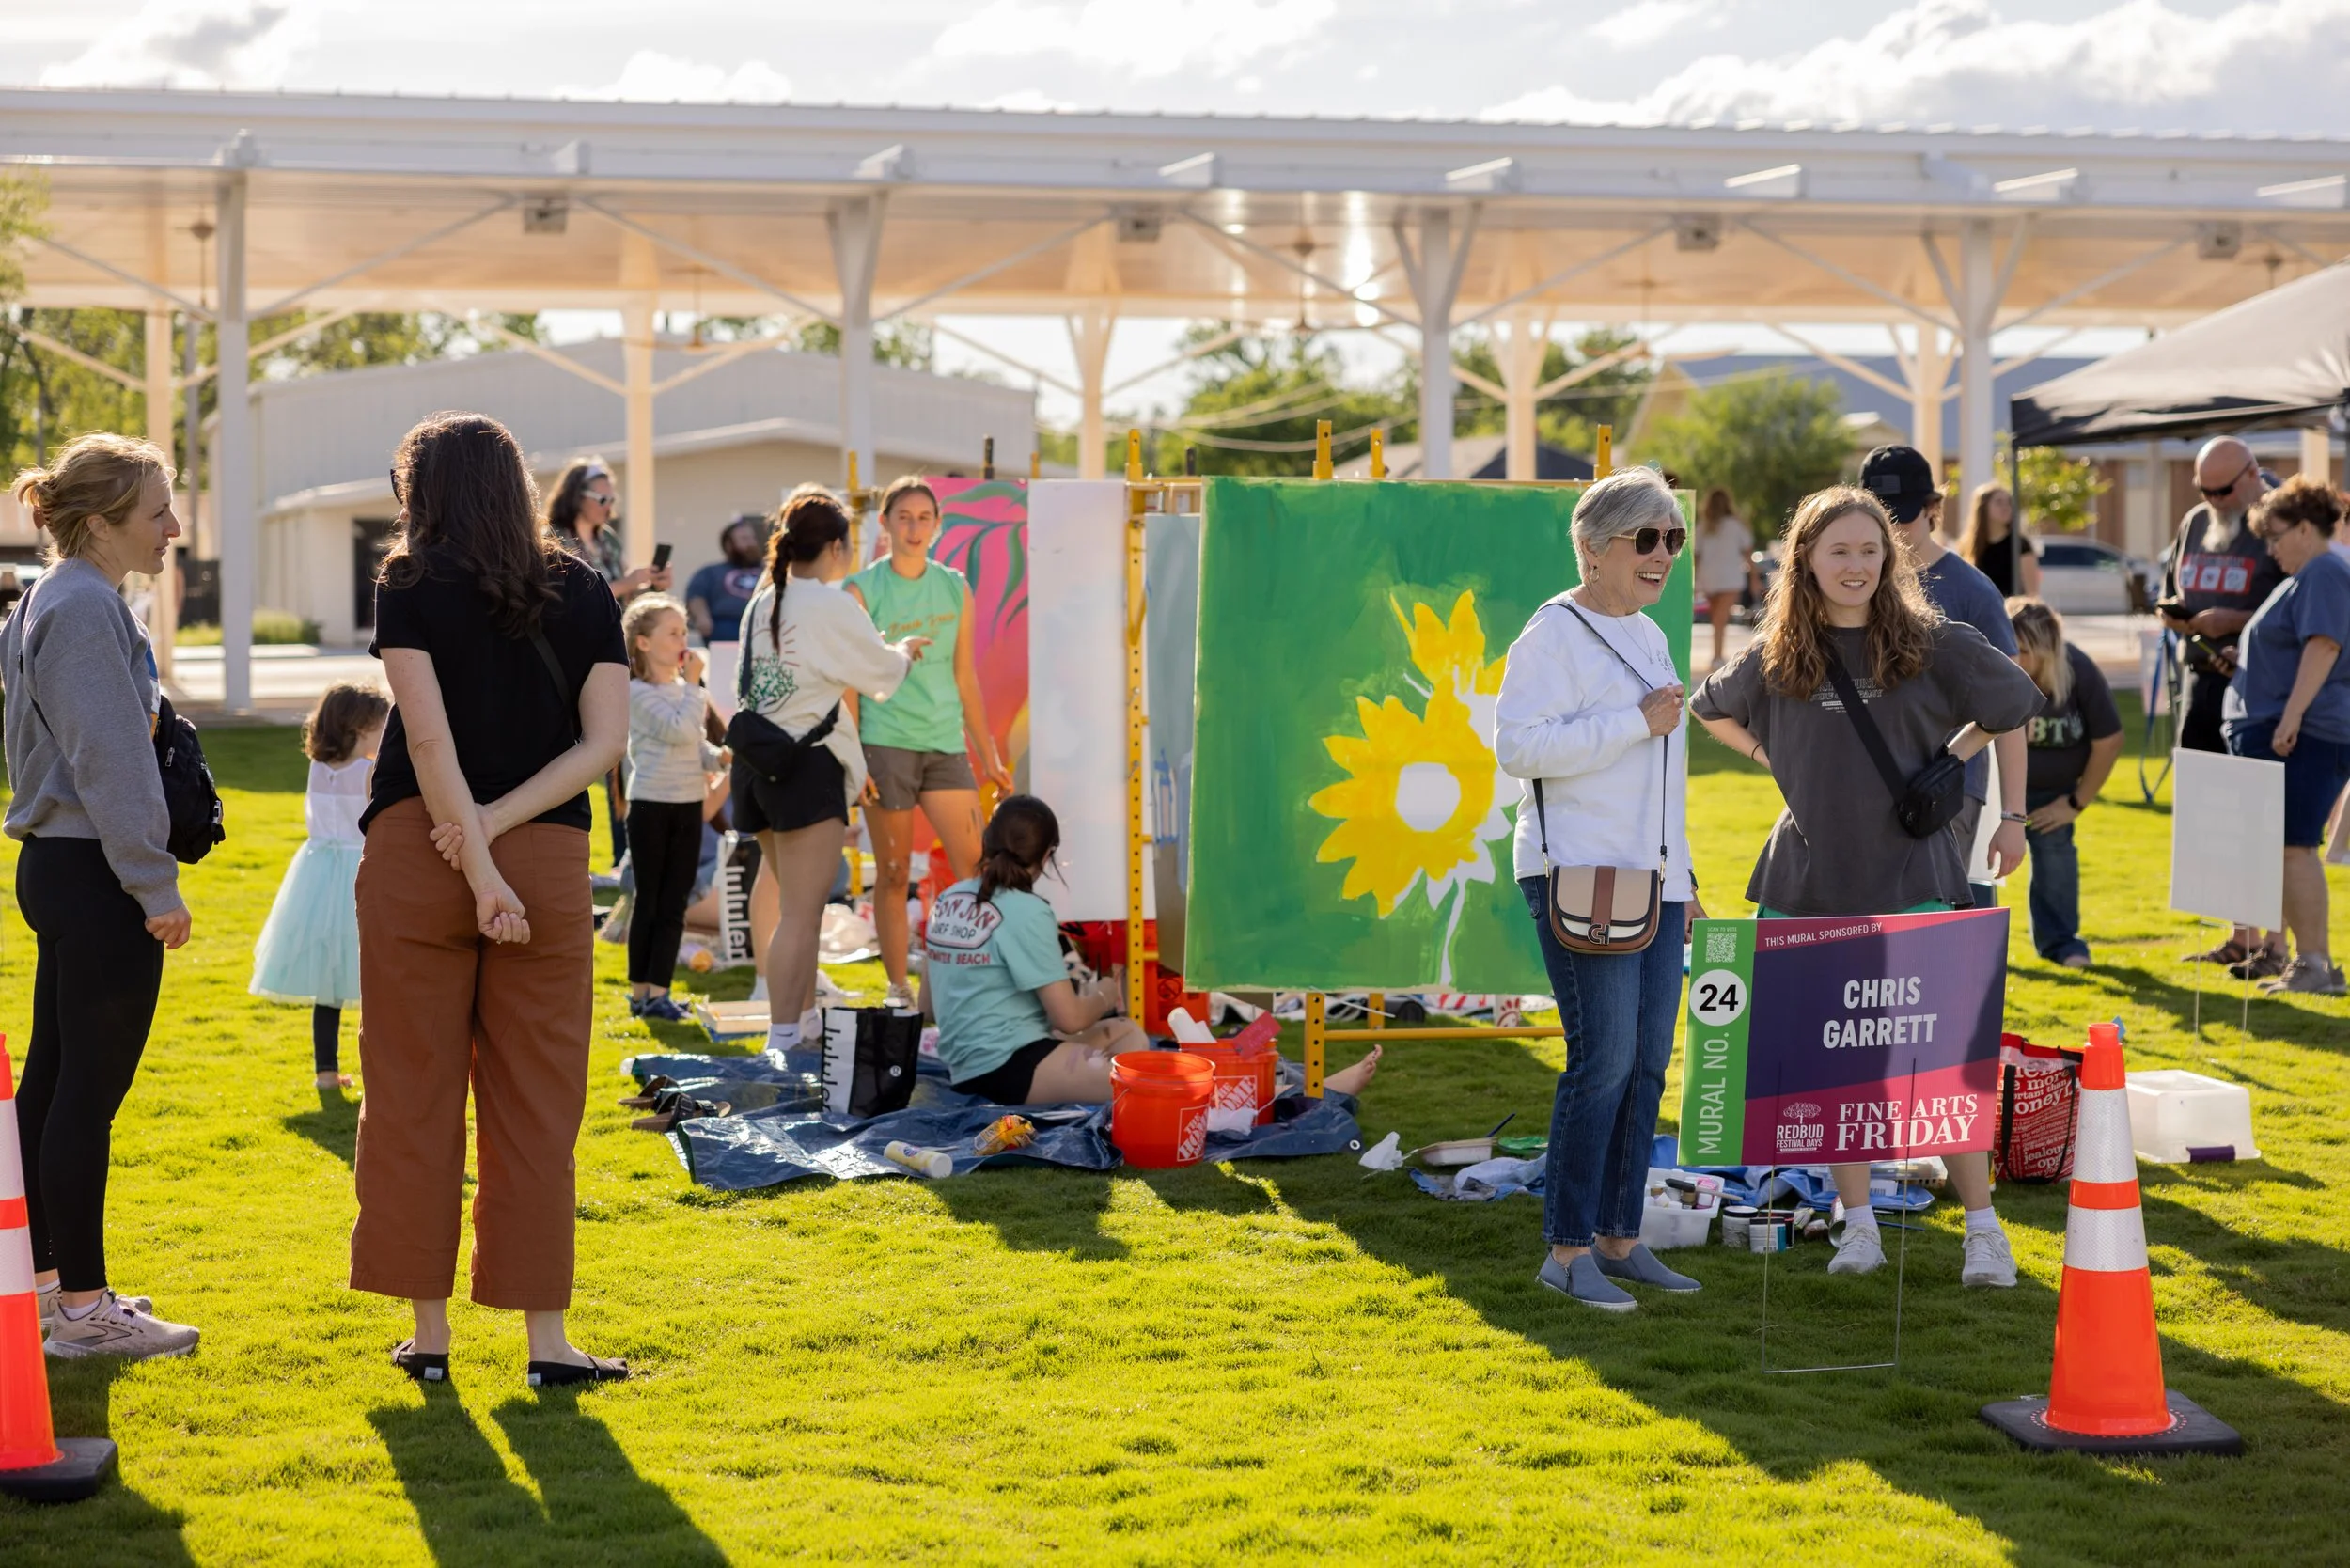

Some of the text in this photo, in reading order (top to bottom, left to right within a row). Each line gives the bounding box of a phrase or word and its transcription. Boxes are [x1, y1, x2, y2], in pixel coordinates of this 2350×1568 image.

[1765, 922, 1882, 947] THIS MURAL SPONSORED BY
[955, 952, 991, 965] BEACH
[1699, 983, 1739, 1011] 24
[1843, 976, 1921, 1009] CHRIS
[1823, 1013, 1937, 1049] GARRETT
[1697, 1032, 1730, 1154] MURAL NO.
[2014, 1087, 2062, 1115] oney
[1838, 1094, 1978, 1122] FINE ARTS
[1776, 1124, 1824, 1139] REDBUD
[1776, 1138, 1823, 1148] FESTIVAL DAYS
[1835, 1115, 1979, 1152] FRIDAY
